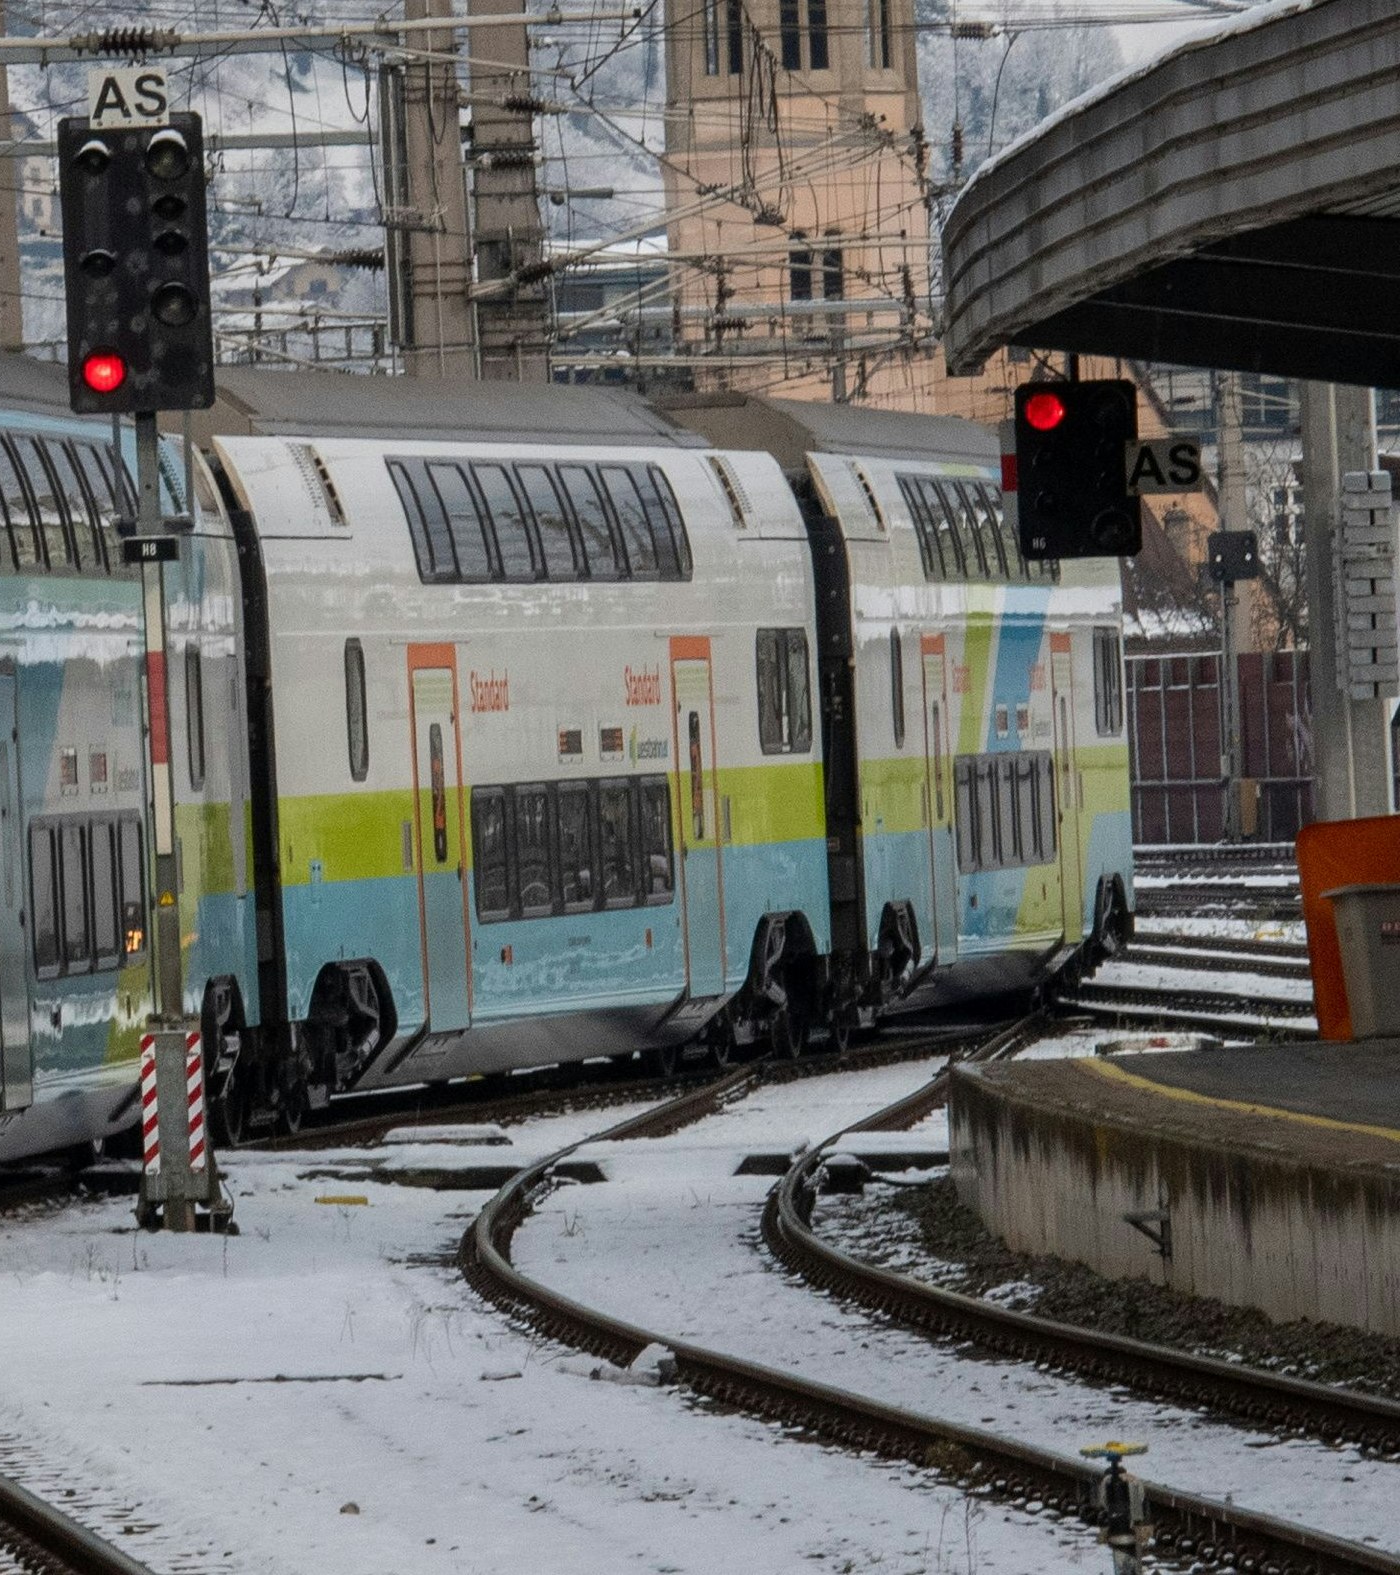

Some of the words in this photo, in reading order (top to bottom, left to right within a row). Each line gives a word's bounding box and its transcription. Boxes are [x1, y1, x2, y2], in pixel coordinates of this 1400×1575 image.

[92, 74, 167, 119] AS
[1128, 444, 1200, 486] AS
[471, 667, 509, 713] Standard
[624, 662, 661, 706] Standard
